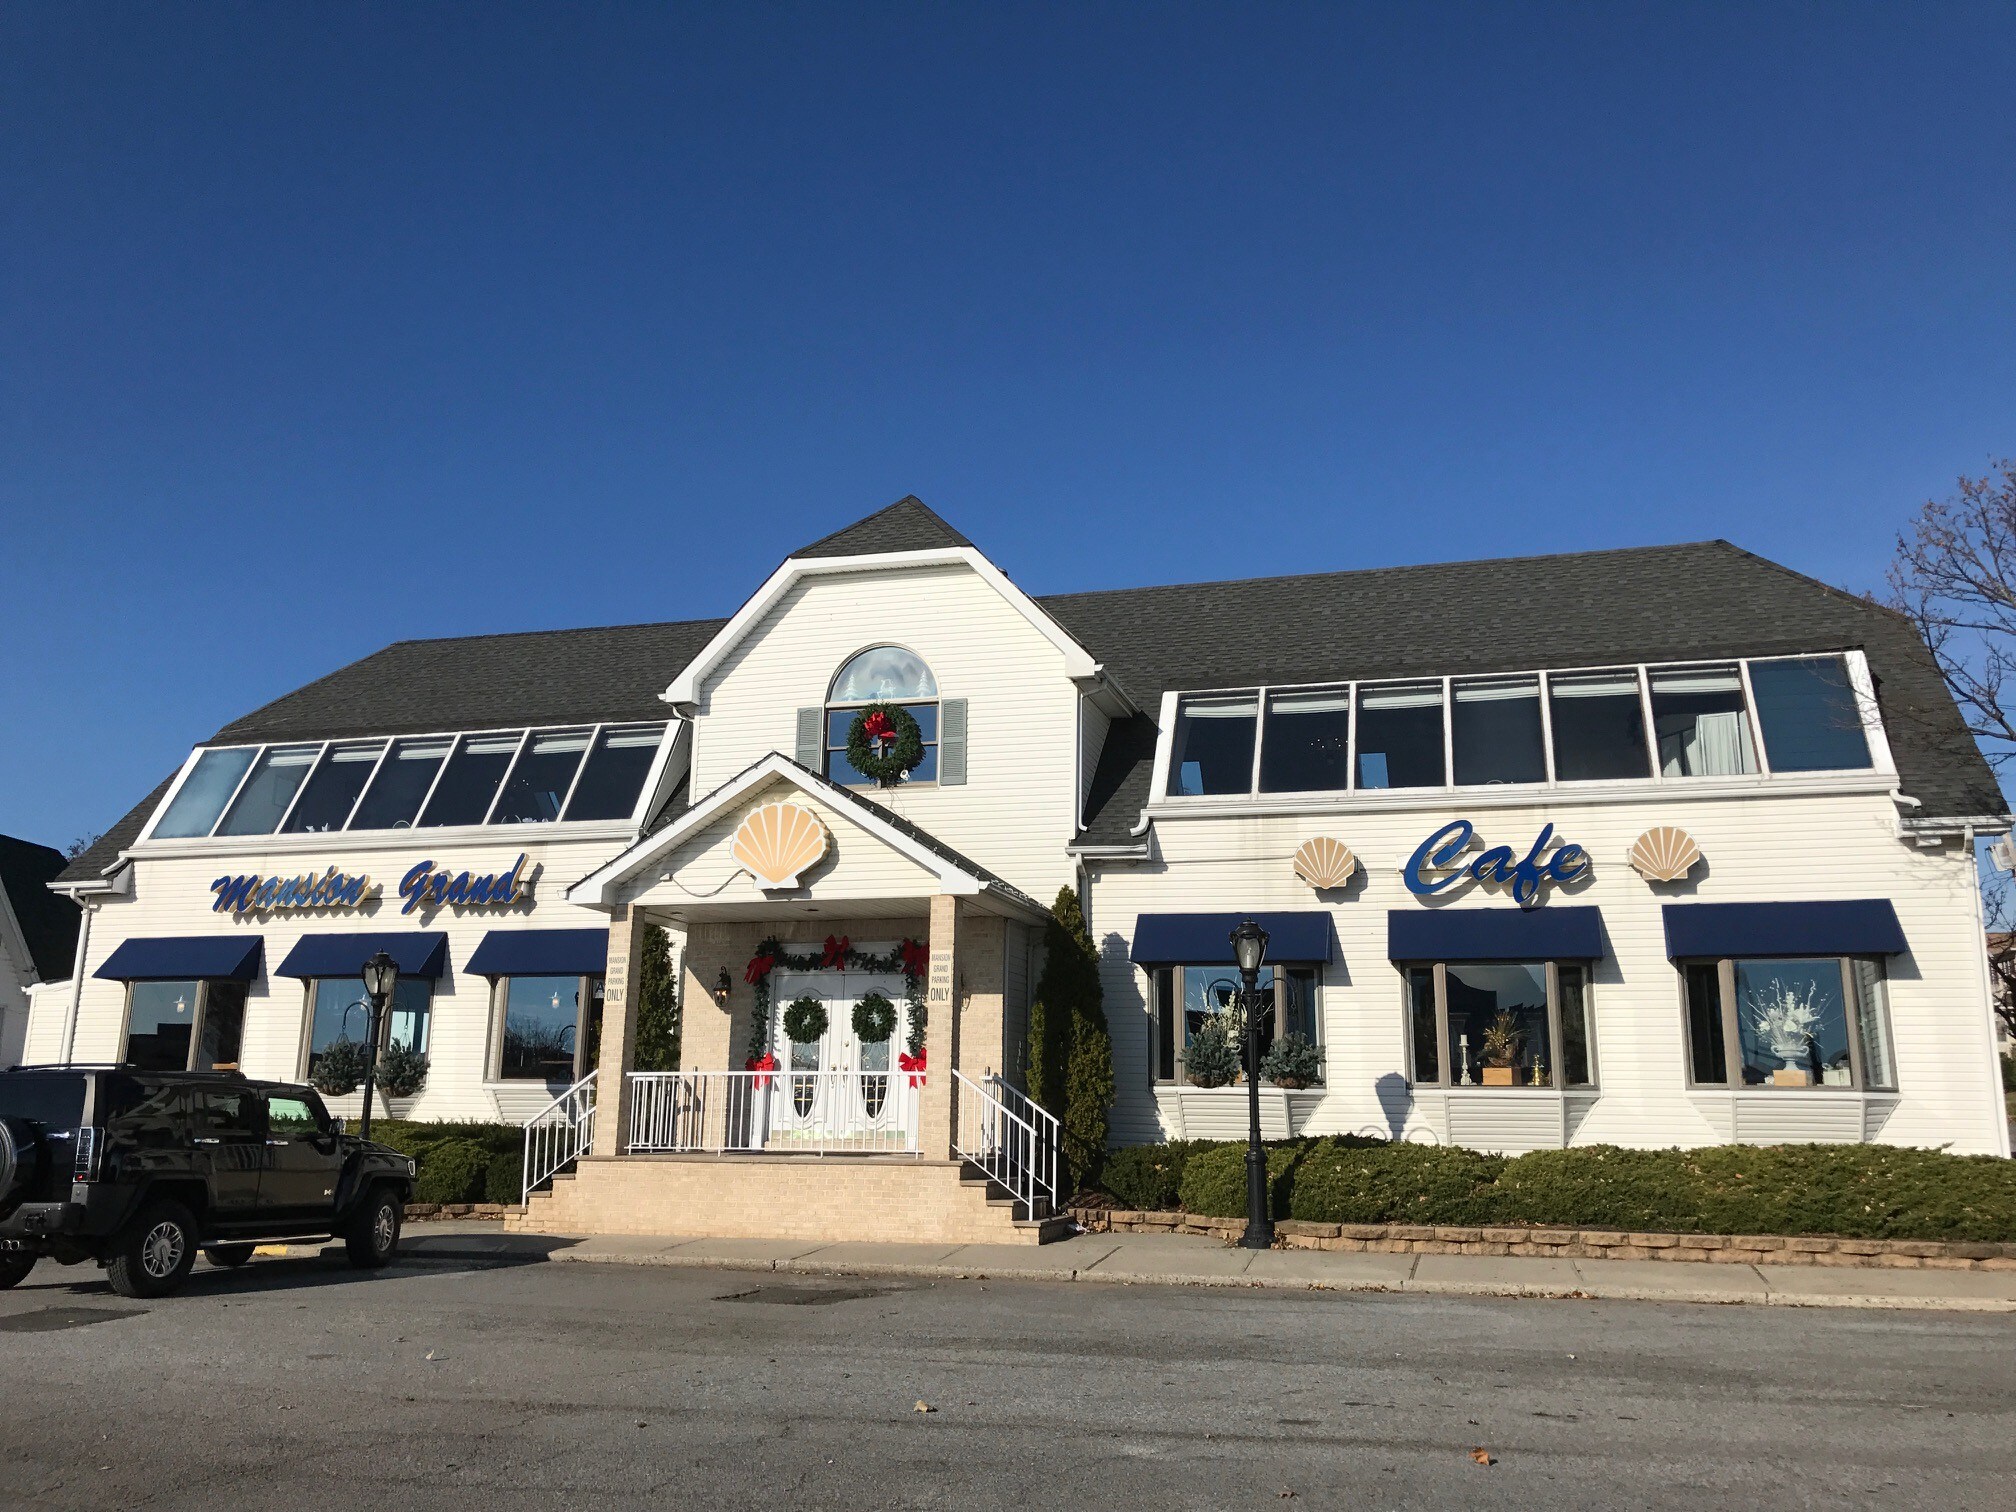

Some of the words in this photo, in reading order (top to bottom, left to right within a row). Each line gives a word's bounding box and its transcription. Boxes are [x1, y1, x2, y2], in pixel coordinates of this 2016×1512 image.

[1403, 819, 1587, 903] Cafe
[210, 864, 370, 914] Mansion
[399, 852, 529, 916] Grand
[608, 956, 627, 965] MANSION
[931, 953, 951, 962] MANSION
[610, 966, 624, 975] GRAND
[933, 964, 949, 973] GRAND
[607, 977, 625, 986] PARKING
[931, 975, 950, 984] PARKING
[606, 988, 625, 1002] ONLY
[930, 987, 950, 1002] ONLY
